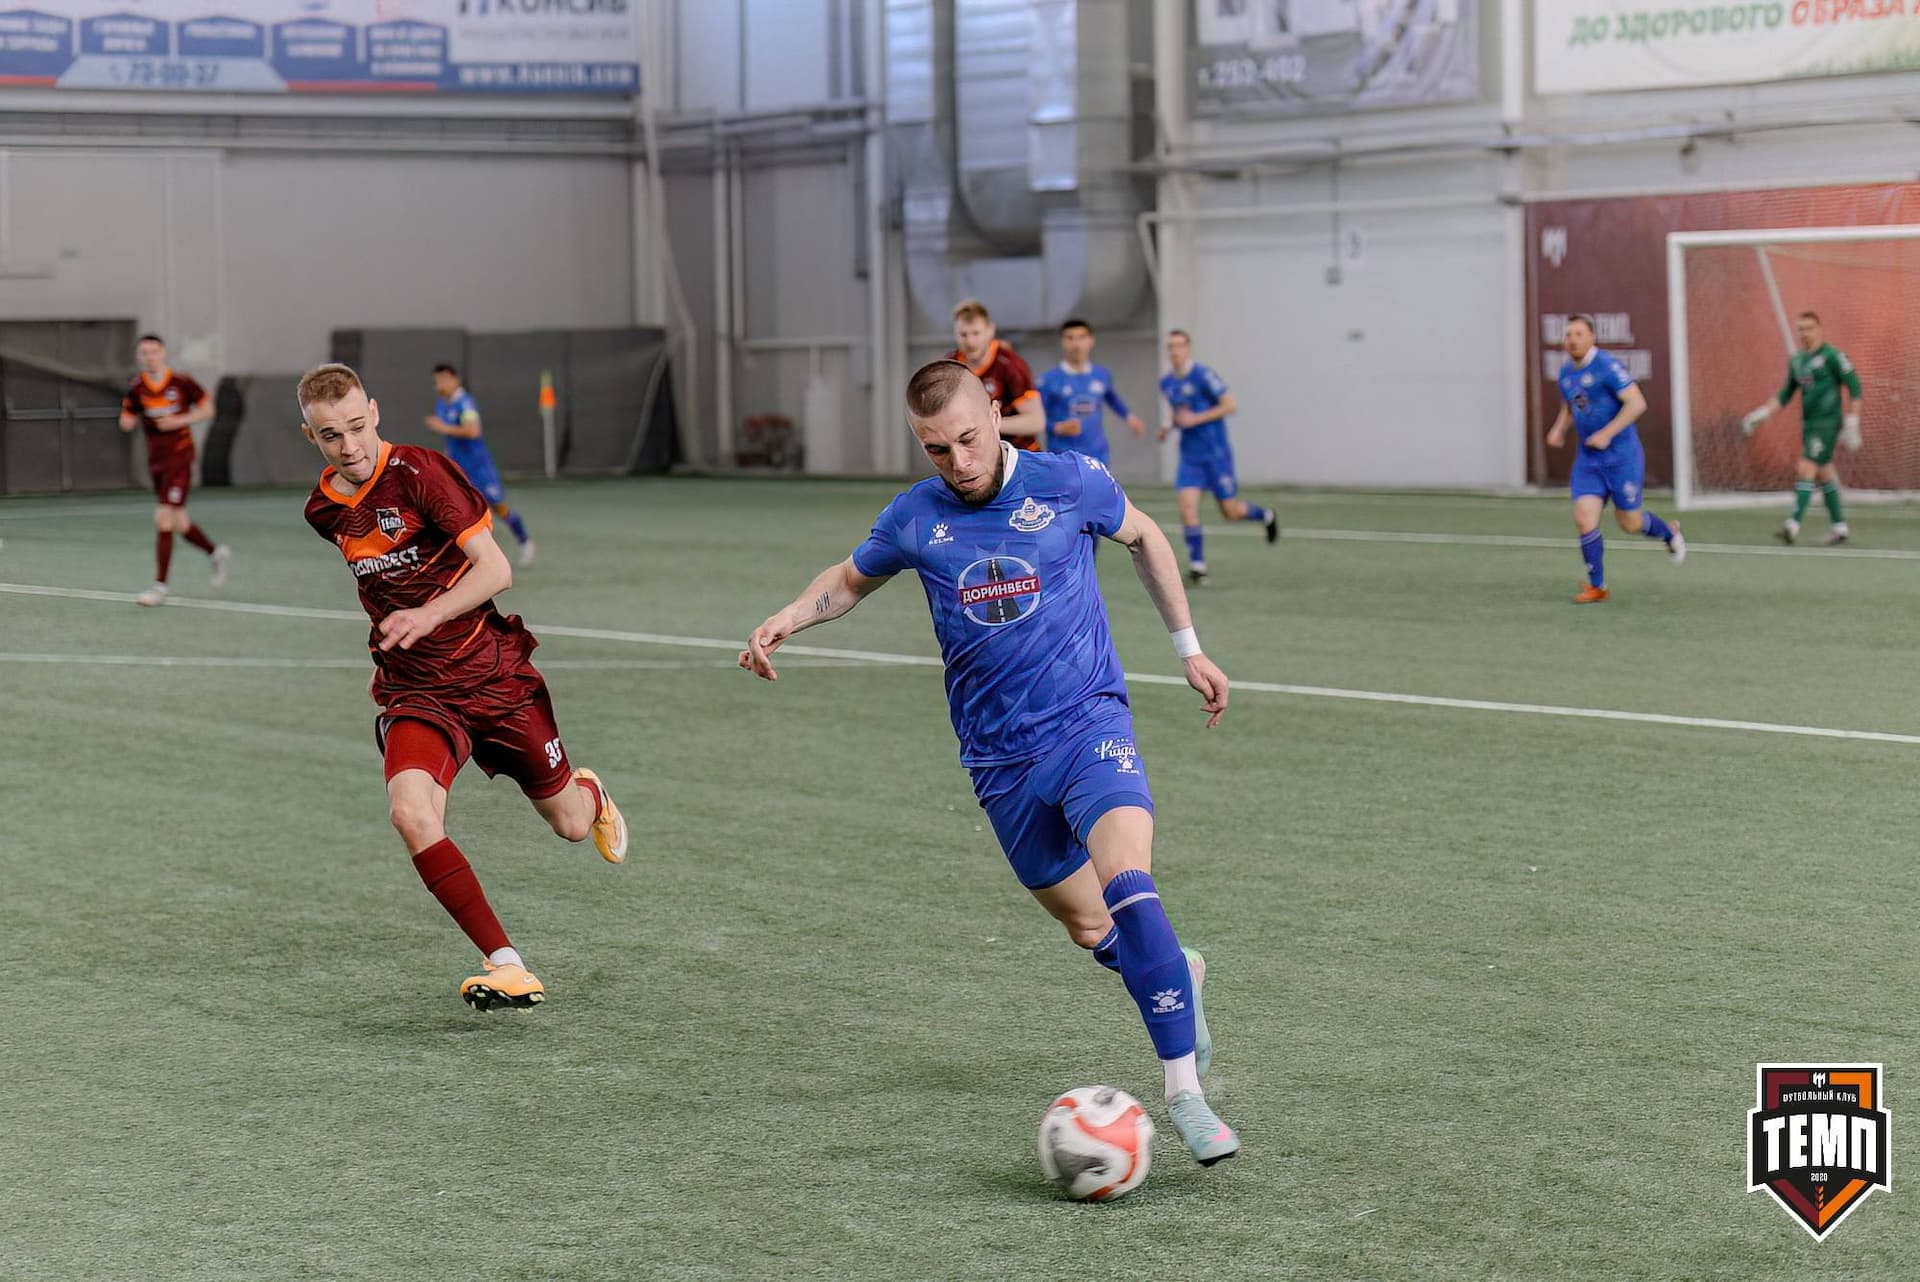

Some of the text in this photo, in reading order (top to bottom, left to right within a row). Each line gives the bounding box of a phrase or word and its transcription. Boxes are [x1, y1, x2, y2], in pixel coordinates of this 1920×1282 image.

[1568, 15, 1611, 47] ДО
[1614, 2, 1783, 44] ЗДОРОВОГО
[962, 578, 1037, 604] ДОРИНВЕСТ
